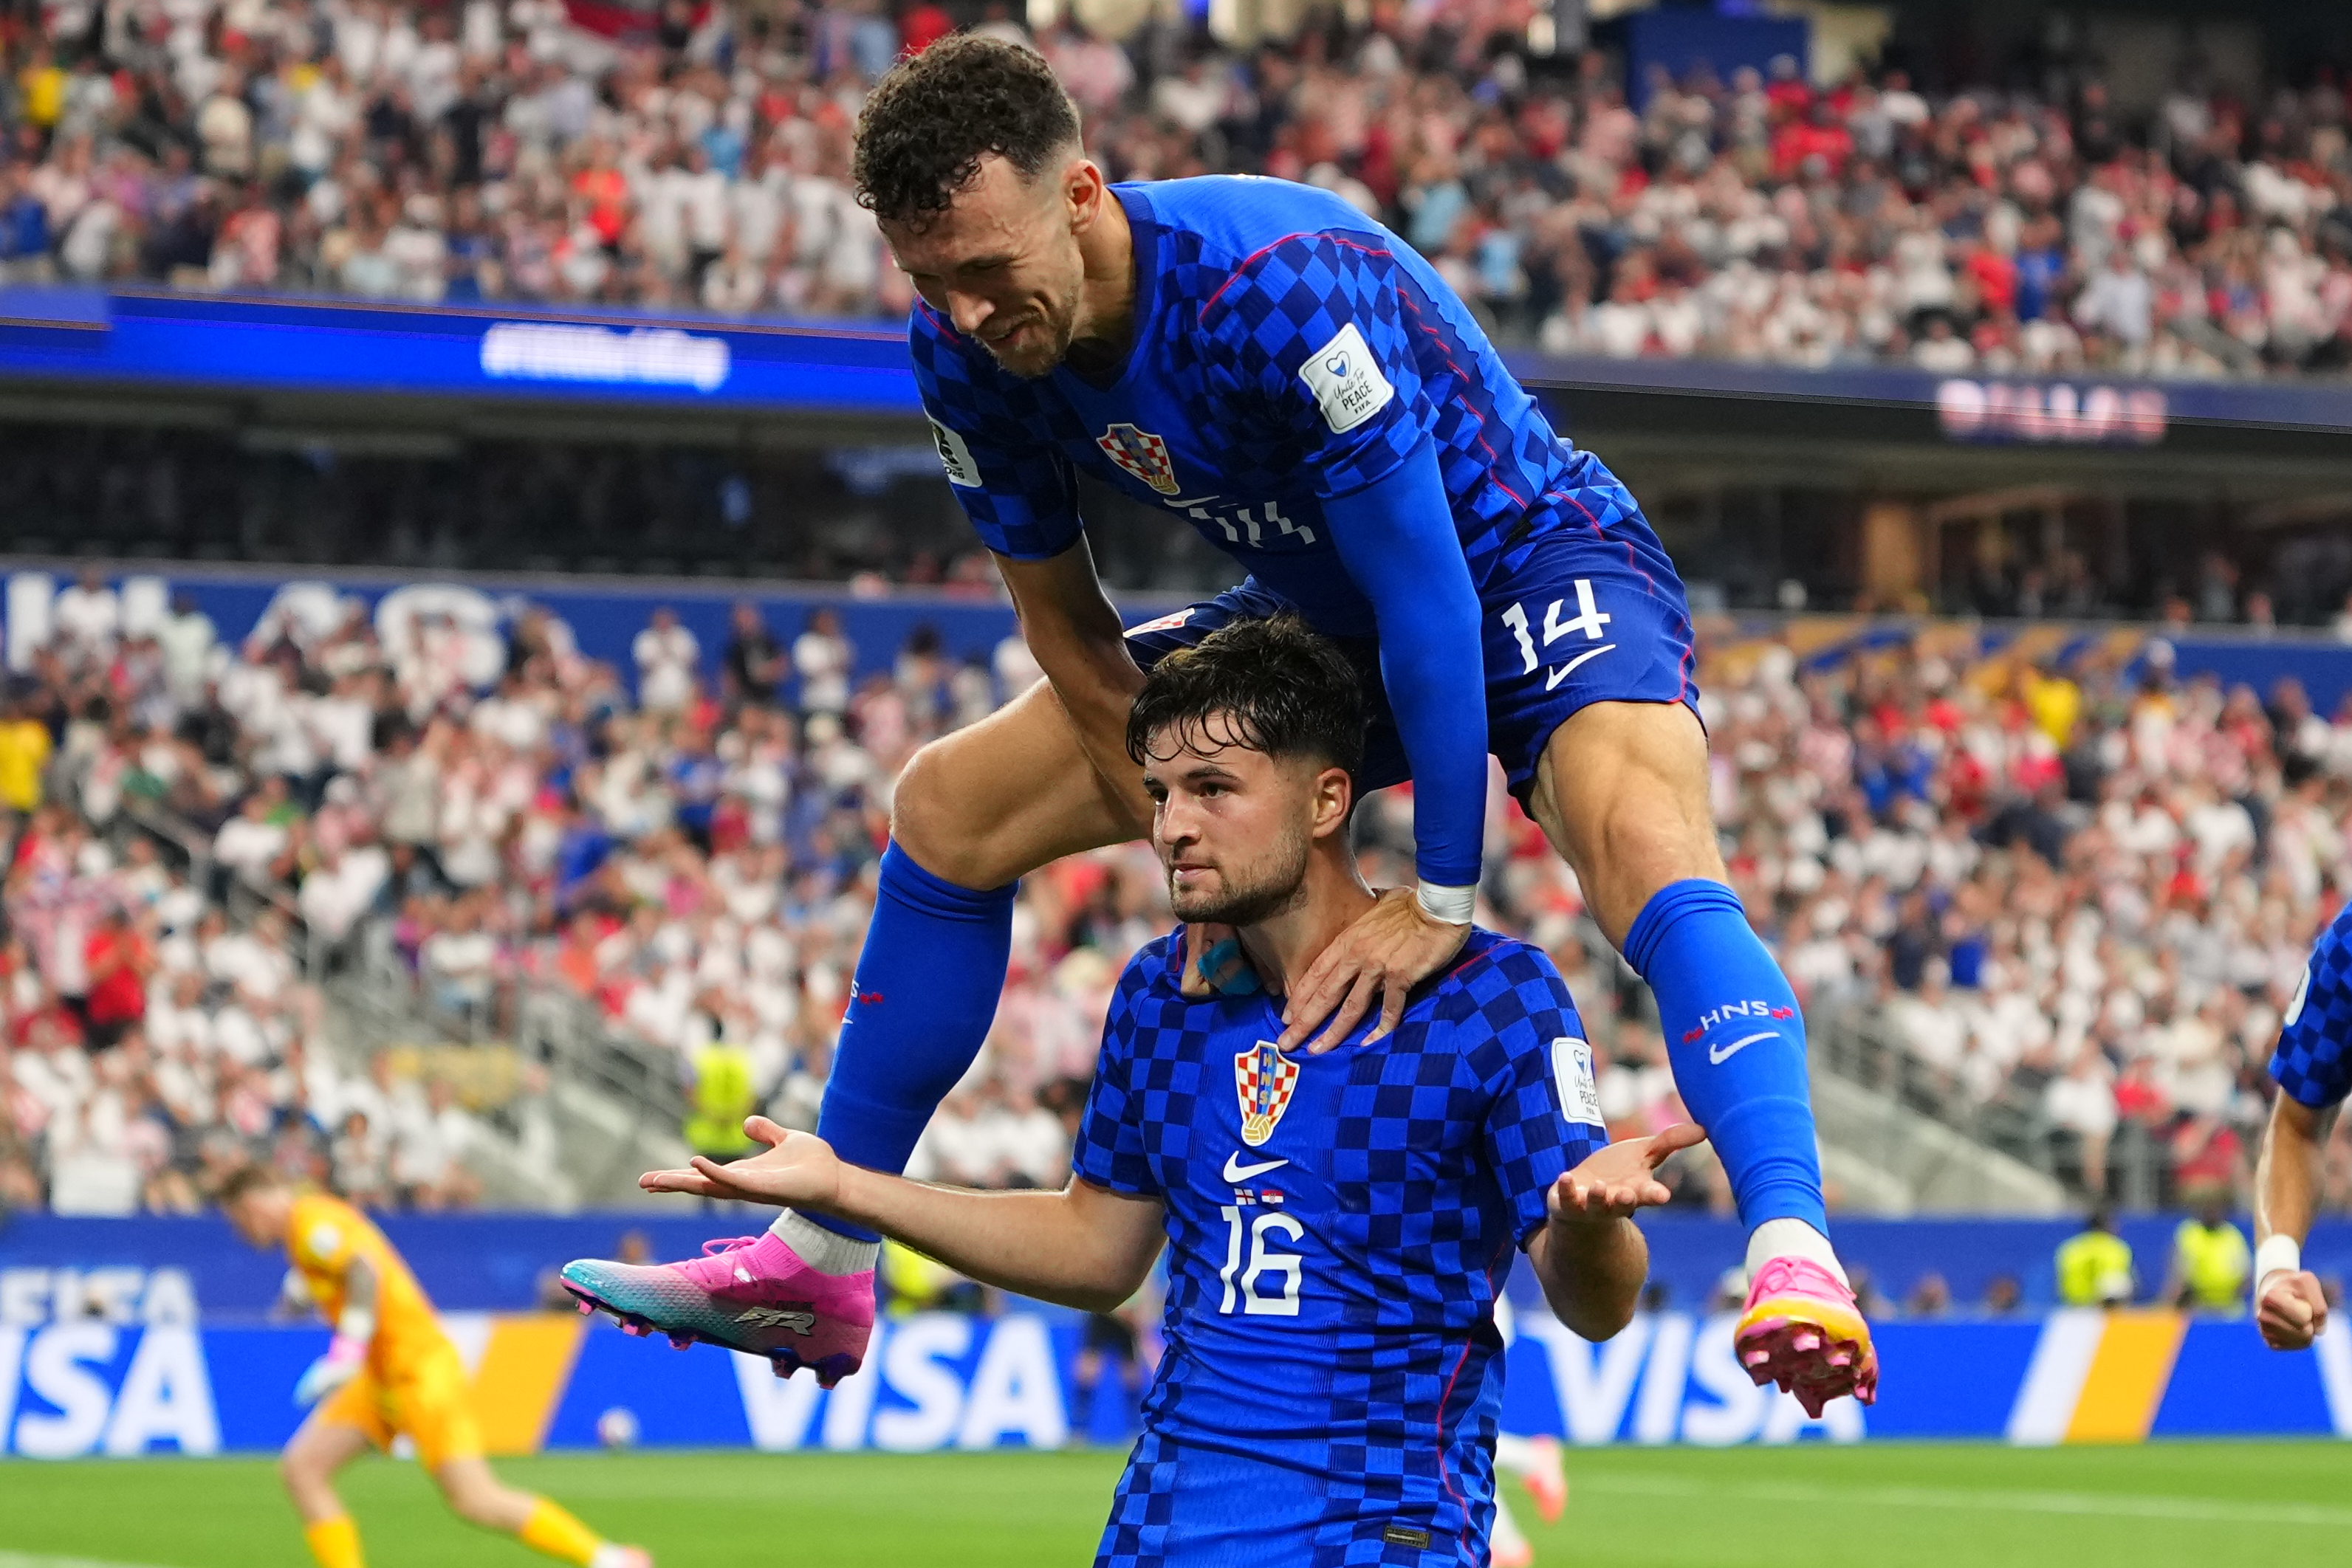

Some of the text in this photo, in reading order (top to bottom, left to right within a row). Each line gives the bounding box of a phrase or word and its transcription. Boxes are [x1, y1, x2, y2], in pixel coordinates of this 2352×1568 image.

[1342, 380, 1372, 410] PEACE
[1354, 400, 1371, 414] FIFA
[1501, 579, 1611, 675] 14
[1700, 1000, 1769, 1031] HNS
[1219, 1206, 1305, 1316] 16
